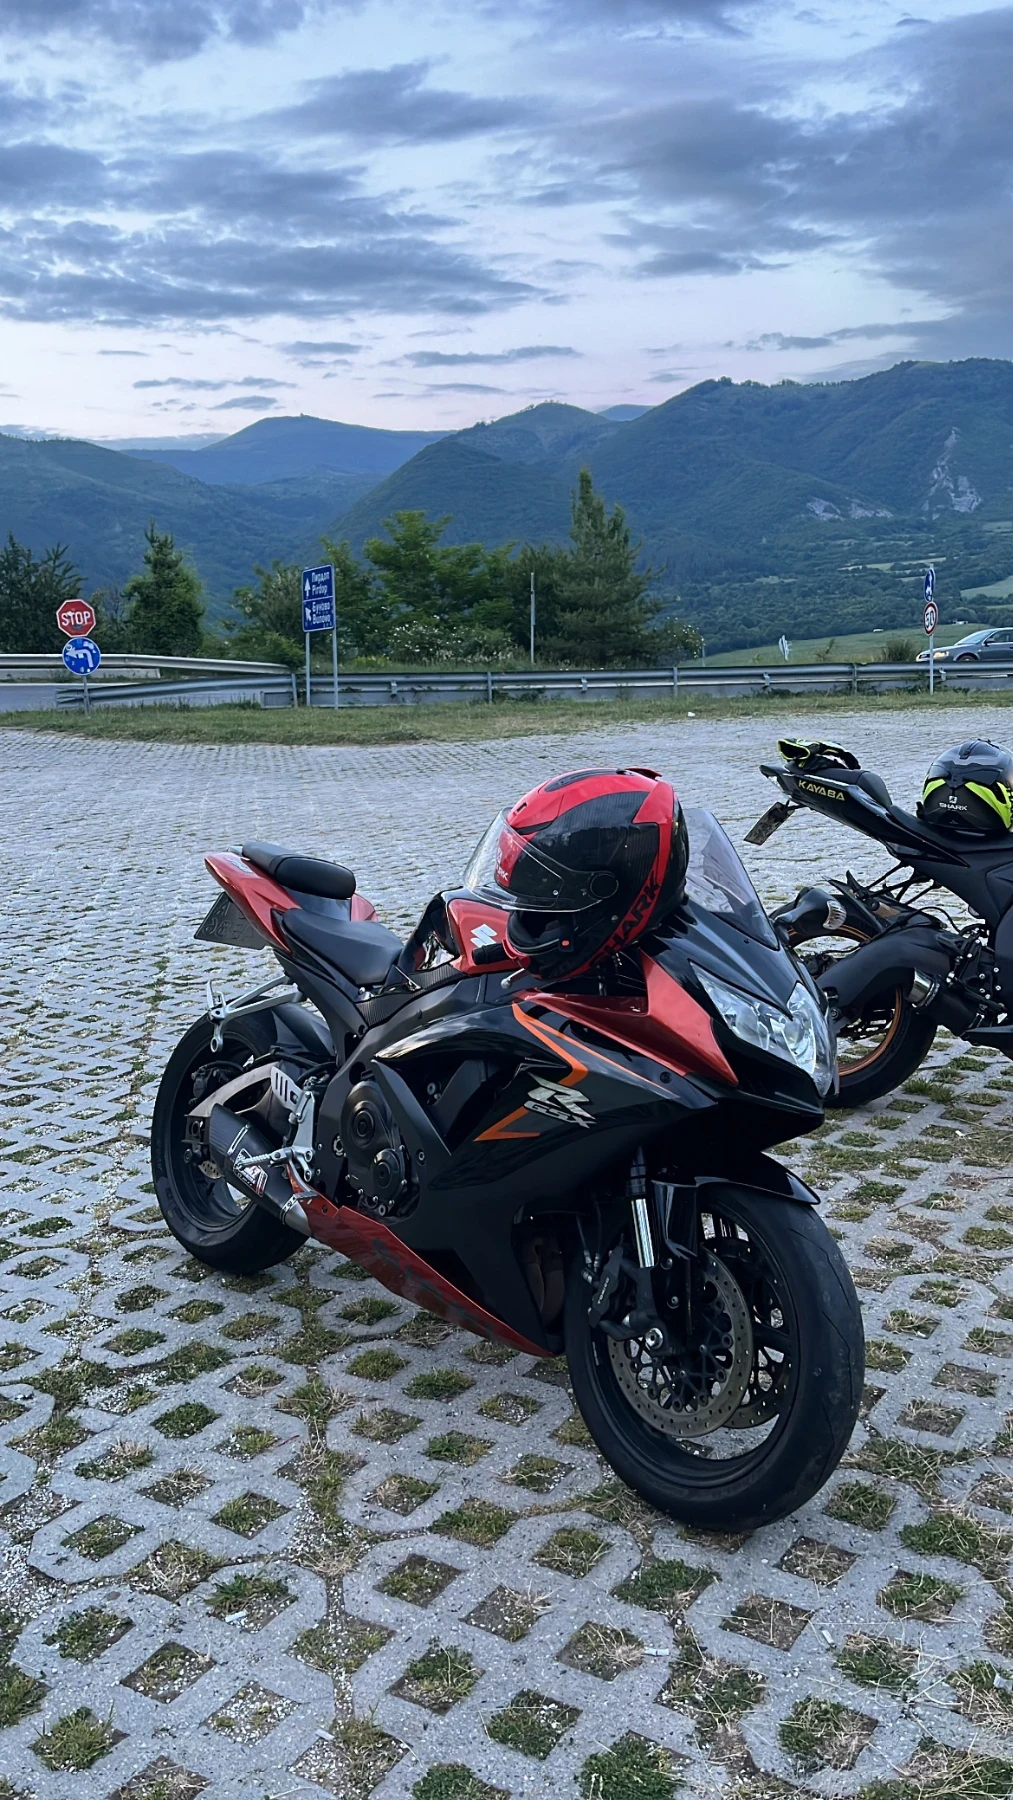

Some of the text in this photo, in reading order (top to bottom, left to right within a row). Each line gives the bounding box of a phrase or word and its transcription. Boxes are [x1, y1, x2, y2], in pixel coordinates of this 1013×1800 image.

[61, 611, 91, 626] STOP
[925, 610, 935, 628] 50
[798, 780, 846, 801] KAYABA
[939, 802, 968, 811] SHARK
[523, 1100, 597, 1129] GSX
